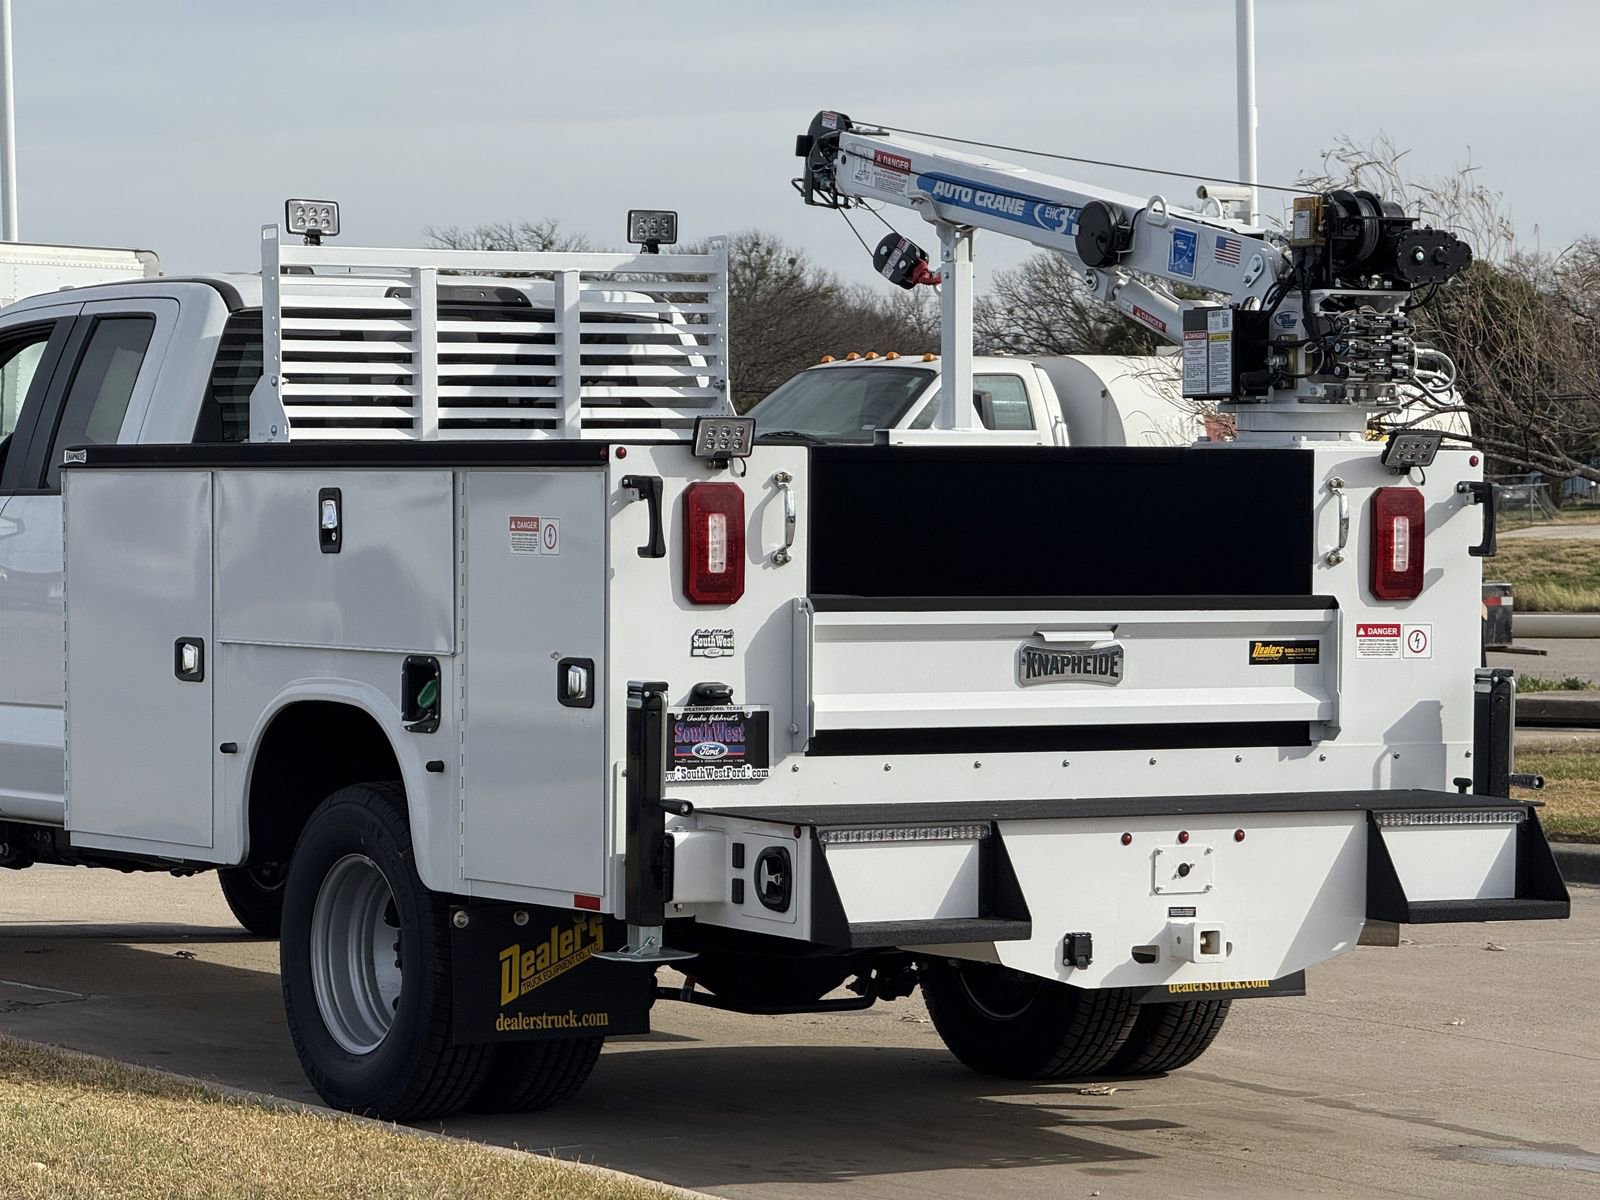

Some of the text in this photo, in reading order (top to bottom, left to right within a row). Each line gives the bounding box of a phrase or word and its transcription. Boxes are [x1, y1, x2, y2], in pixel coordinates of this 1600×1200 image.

[882, 155, 909, 171] DANGER
[932, 181, 1026, 216] AUTO CRANE
[516, 521, 538, 529] DANGER
[1367, 627, 1398, 635] DANGER
[1252, 642, 1284, 657] Dealers
[1026, 650, 1119, 679] KNAPHEIDE
[699, 744, 720, 756] Ford
[499, 915, 604, 1006] Dealers
[523, 974, 544, 991] TRUCK
[543, 956, 574, 981] EQUIPMENT
[495, 1010, 609, 1032] dealerstruck.com
